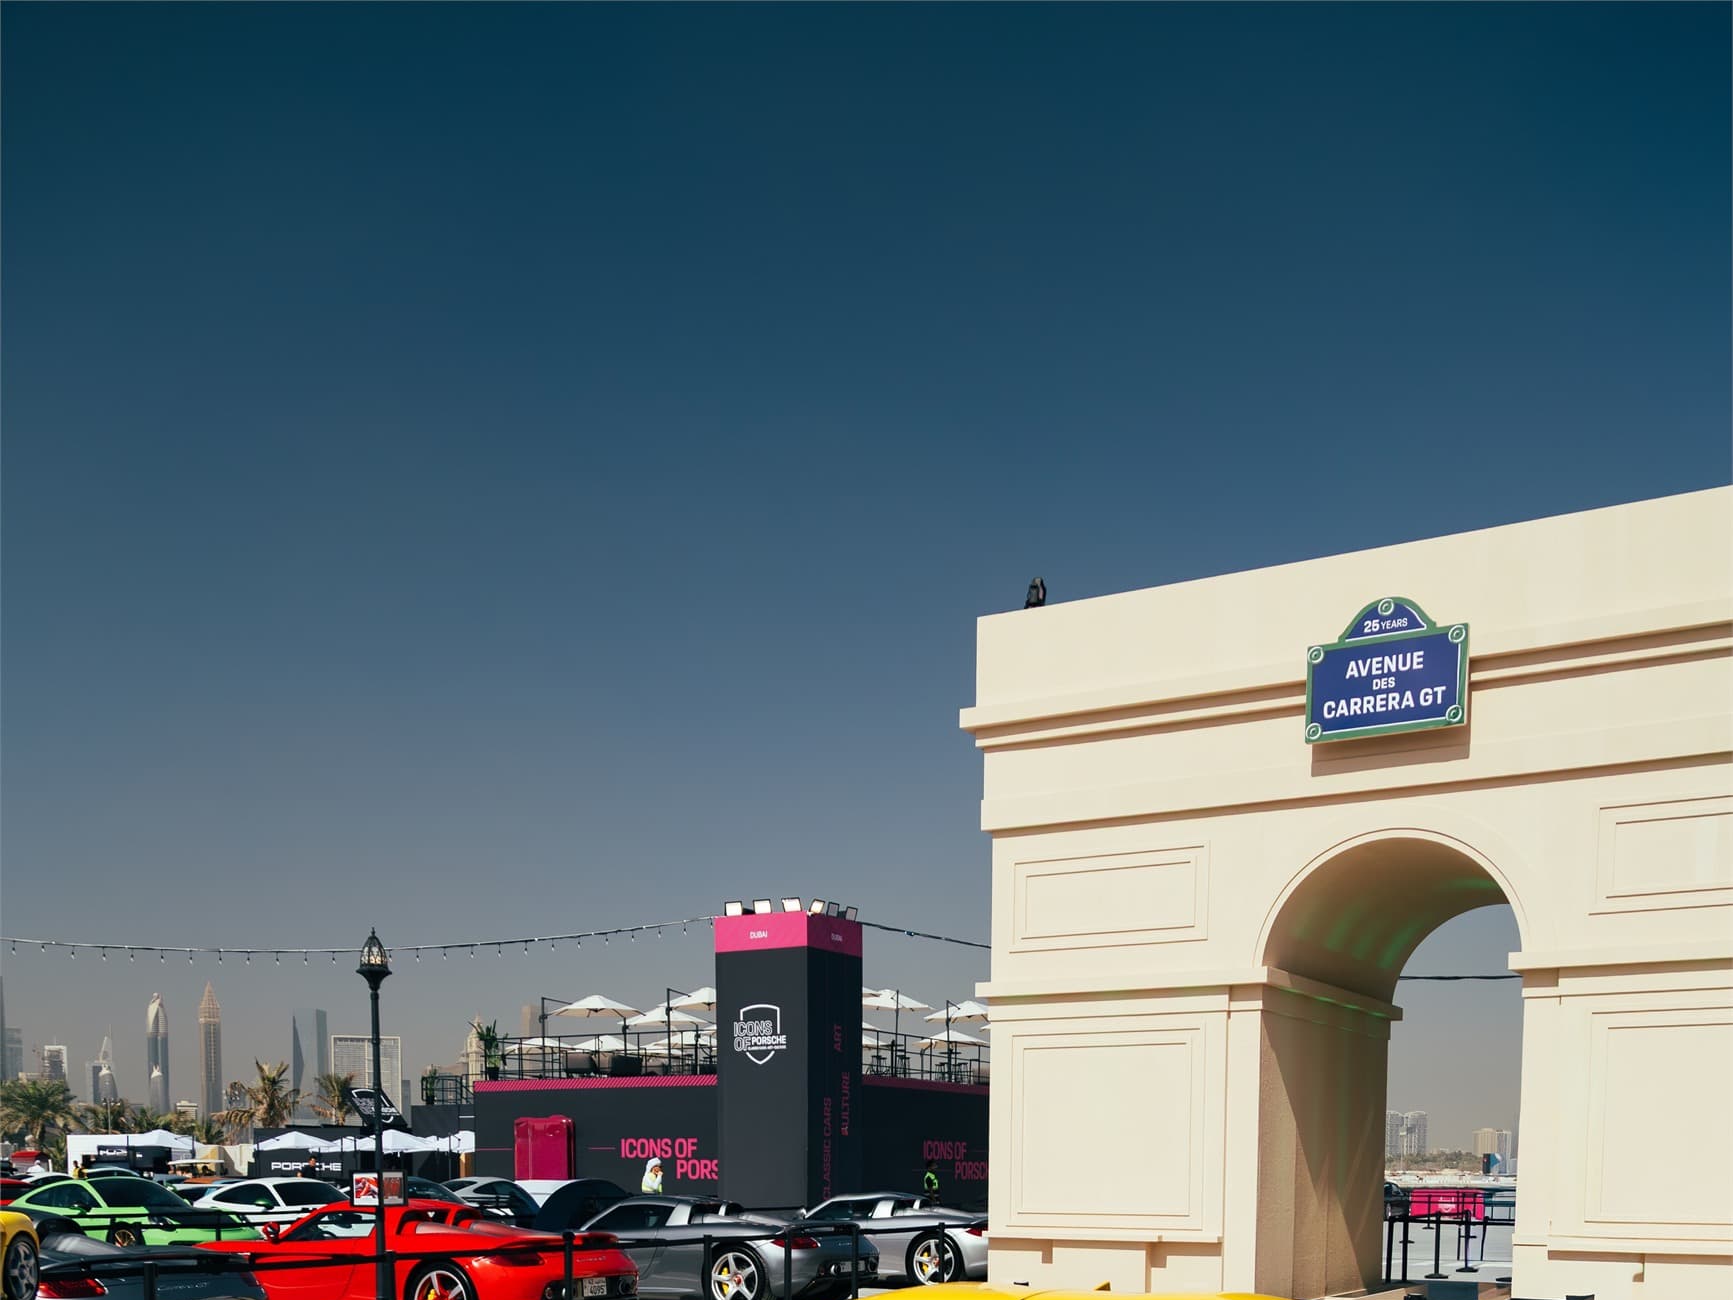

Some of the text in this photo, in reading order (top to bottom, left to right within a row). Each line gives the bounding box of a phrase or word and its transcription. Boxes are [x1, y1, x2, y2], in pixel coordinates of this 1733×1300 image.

[1363, 617, 1408, 633] 25 YEARS
[1345, 651, 1424, 679] AVENUE
[1372, 677, 1395, 690] DES
[1323, 686, 1446, 719] CARRERA GT
[749, 930, 768, 939] DUBAI
[733, 1020, 773, 1037] ICONS
[834, 1024, 843, 1052] ART
[733, 1036, 751, 1051] OF
[751, 1035, 787, 1045] PORSCHE
[840, 1071, 850, 1131] ULTURE
[823, 1097, 833, 1137] CARS
[620, 1138, 698, 1158] ICONS OF
[923, 1140, 967, 1161] ICONS OF
[271, 1161, 342, 1172] PORHE
[954, 1161, 989, 1180] PORSC
